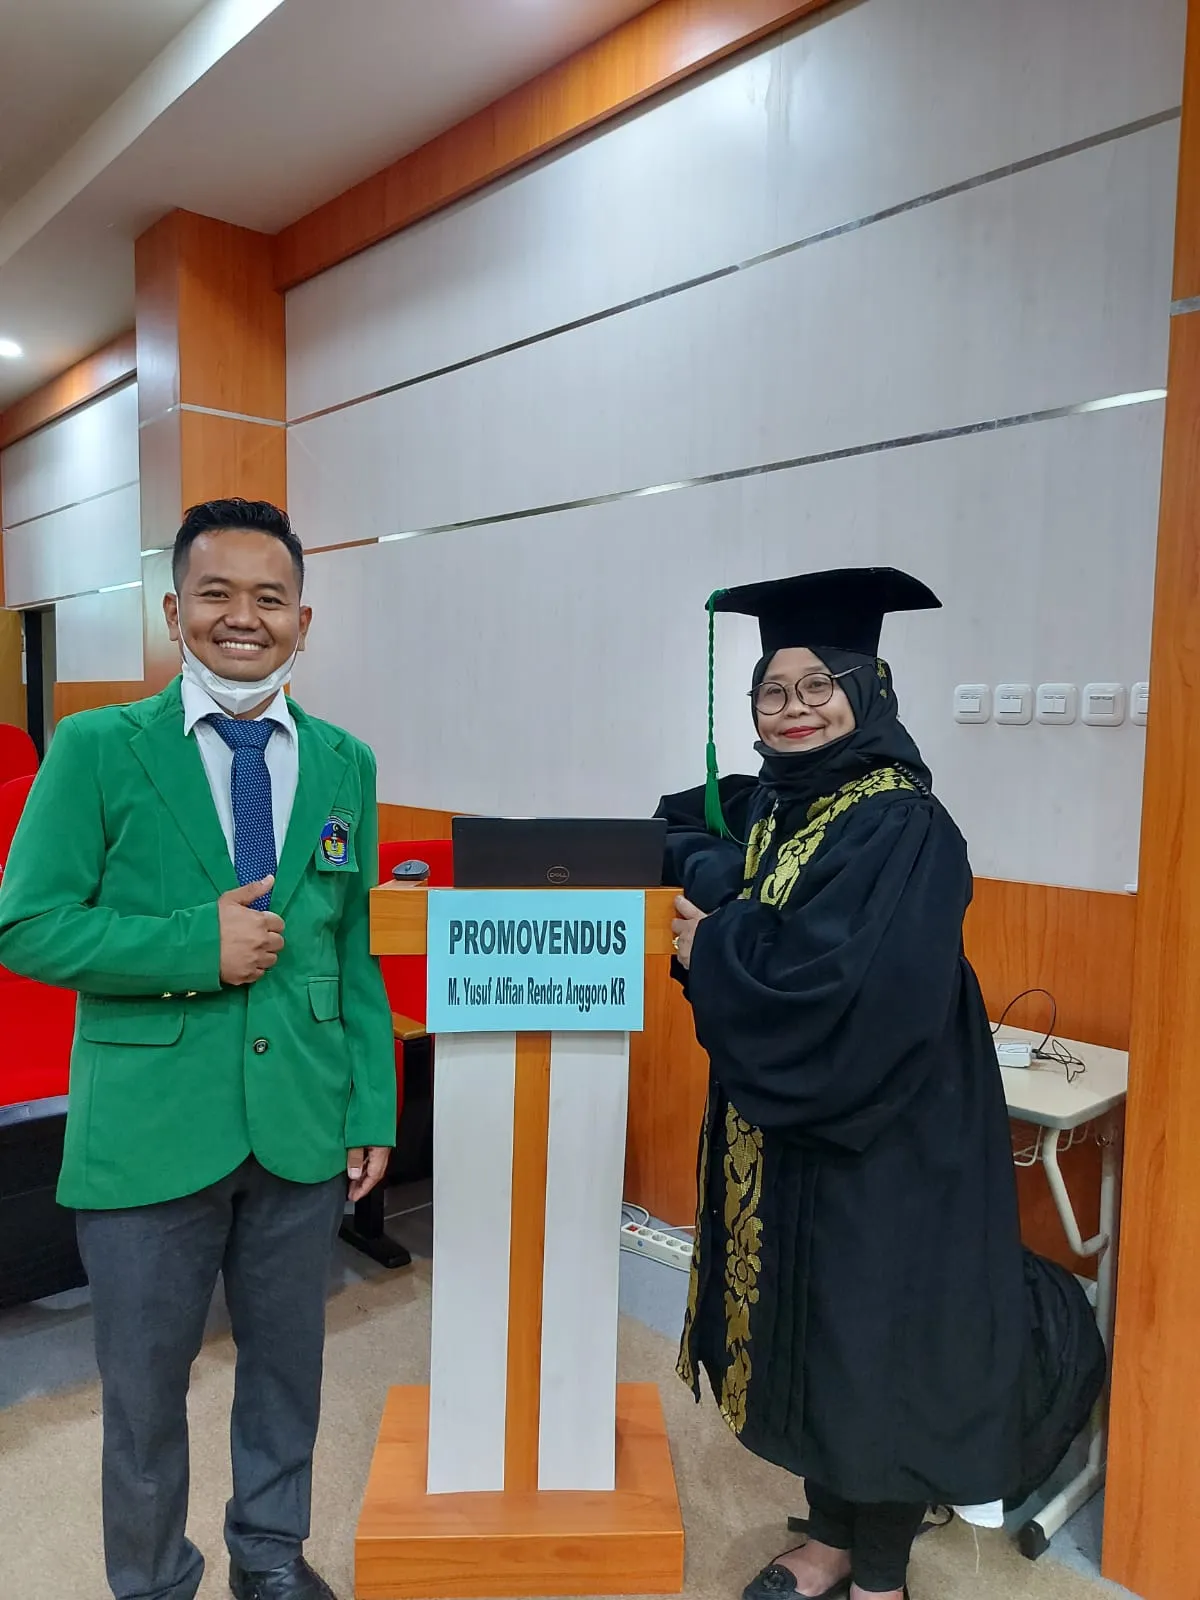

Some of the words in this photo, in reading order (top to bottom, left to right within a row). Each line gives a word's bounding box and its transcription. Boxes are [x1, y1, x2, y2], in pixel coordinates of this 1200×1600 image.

[449, 919, 627, 955] PROMOVENDUS
[448, 977, 460, 1006] M.
[463, 976, 492, 1006] Yusuf
[494, 976, 524, 1005] Alfian
[527, 977, 563, 1005] Rendra
[565, 977, 608, 1013] Anggoro
[610, 977, 625, 1005] KR
